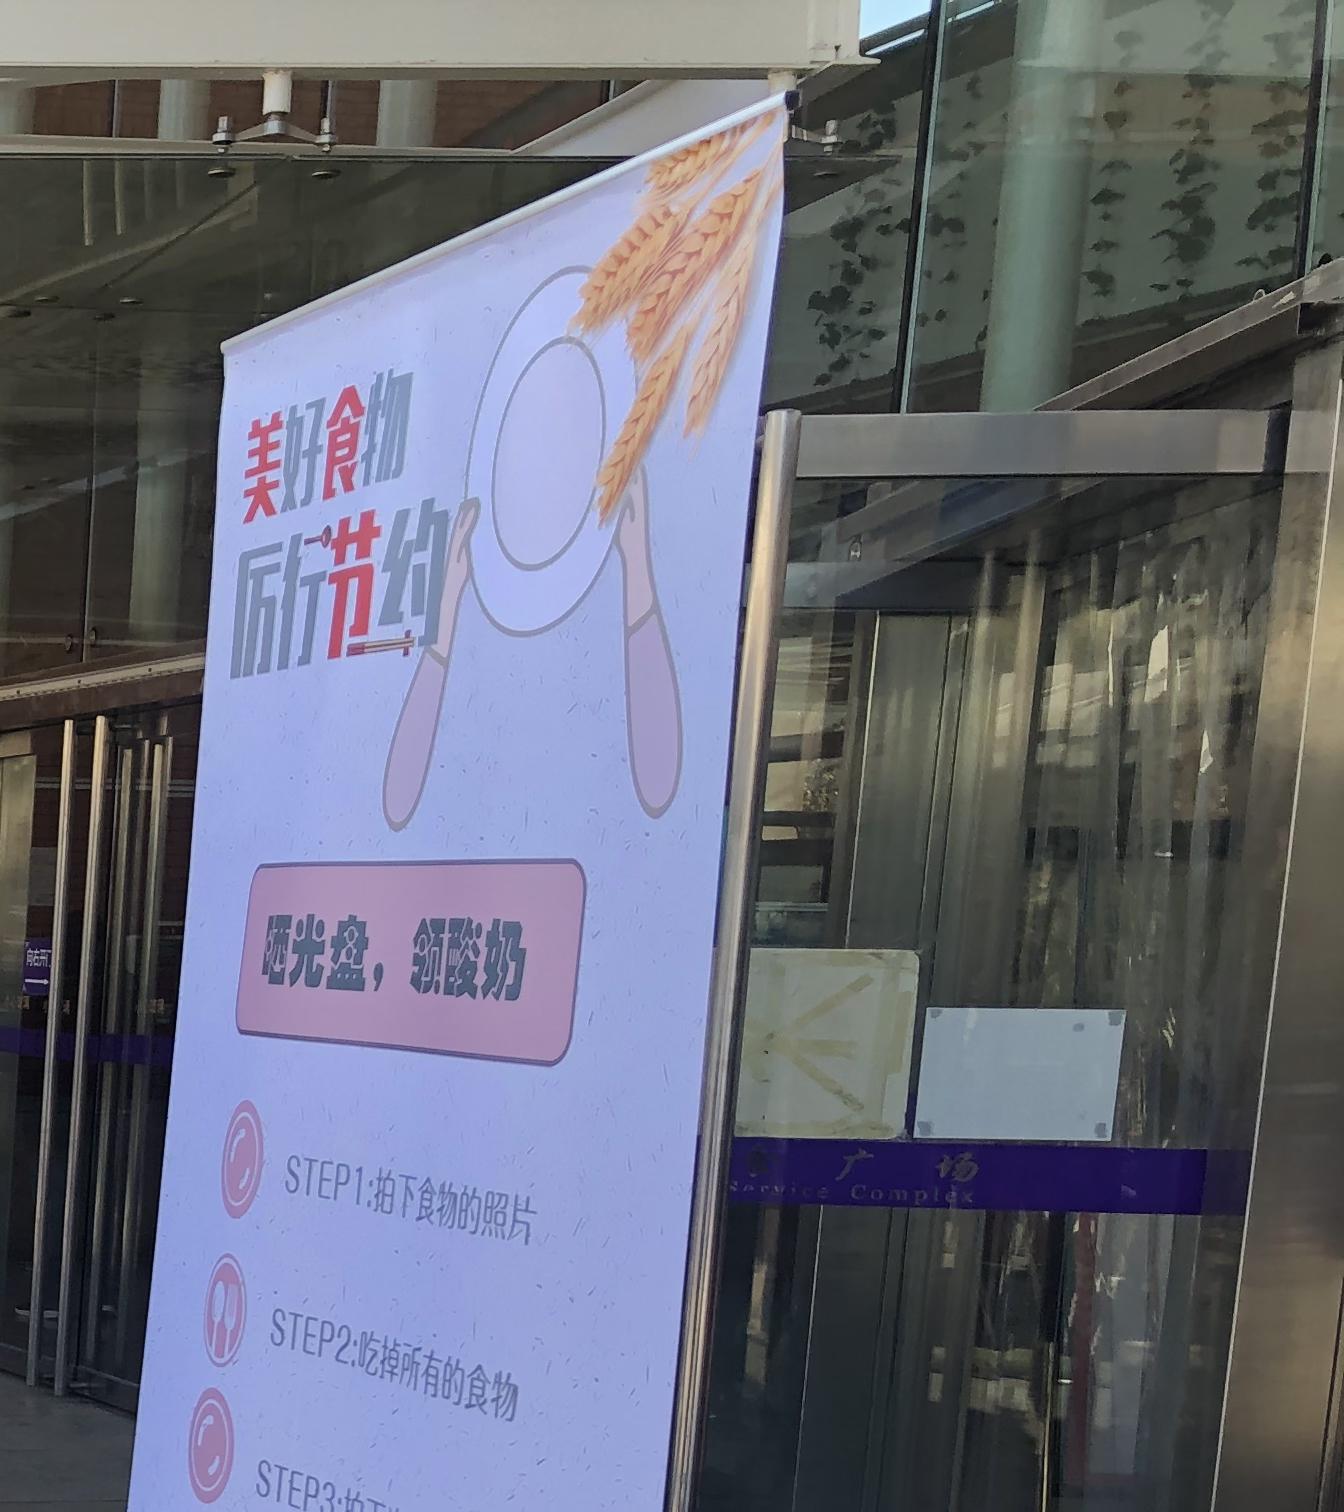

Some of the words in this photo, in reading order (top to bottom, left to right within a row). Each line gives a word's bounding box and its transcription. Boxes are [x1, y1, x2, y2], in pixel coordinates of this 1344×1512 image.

[243, 368, 413, 524] 美好食物
[26, 948, 52, 967] 向右开
[284, 1154, 538, 1246] STEP1:拍下食物的照片
[850, 1184, 974, 1206] Complex
[270, 1308, 520, 1422] STEP2:吃掉所有的食物
